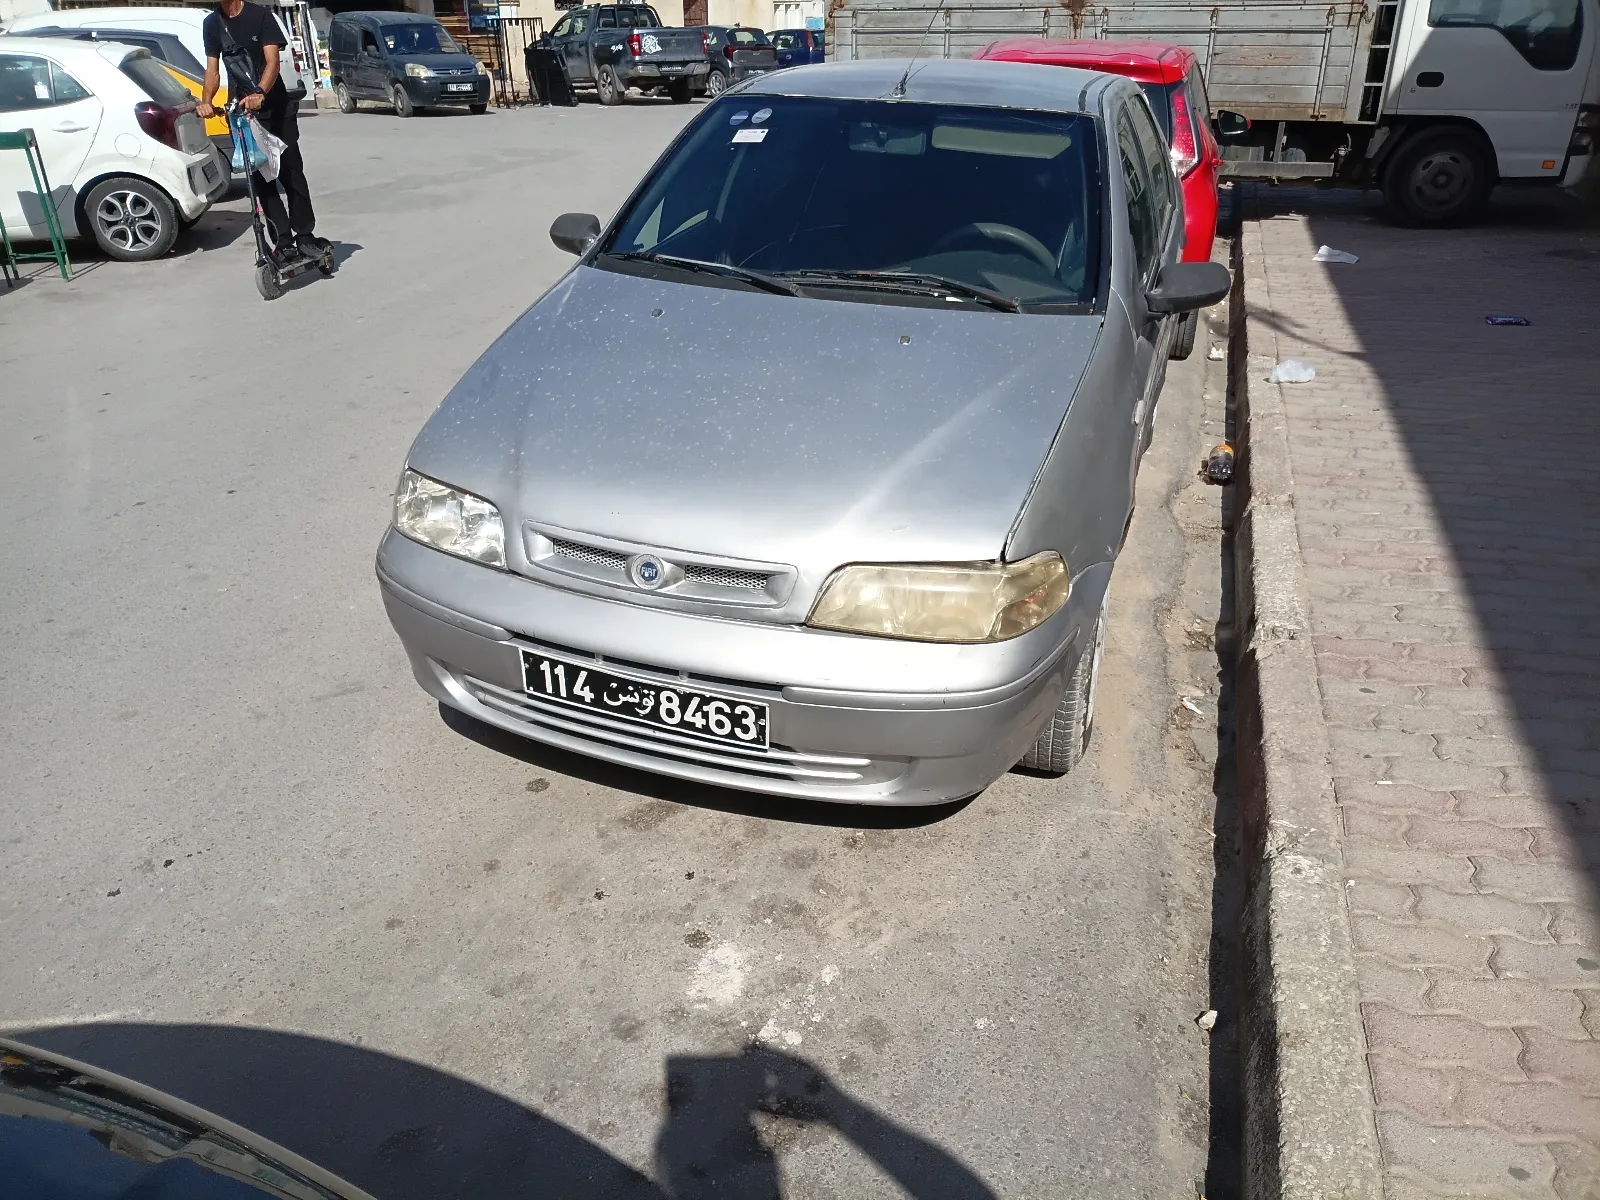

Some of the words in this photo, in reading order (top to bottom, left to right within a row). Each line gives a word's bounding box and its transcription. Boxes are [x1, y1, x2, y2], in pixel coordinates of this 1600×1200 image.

[641, 566, 657, 578] FIAT
[539, 660, 595, 703] 114
[603, 682, 656, 717] تونس
[659, 690, 758, 742] 8463
